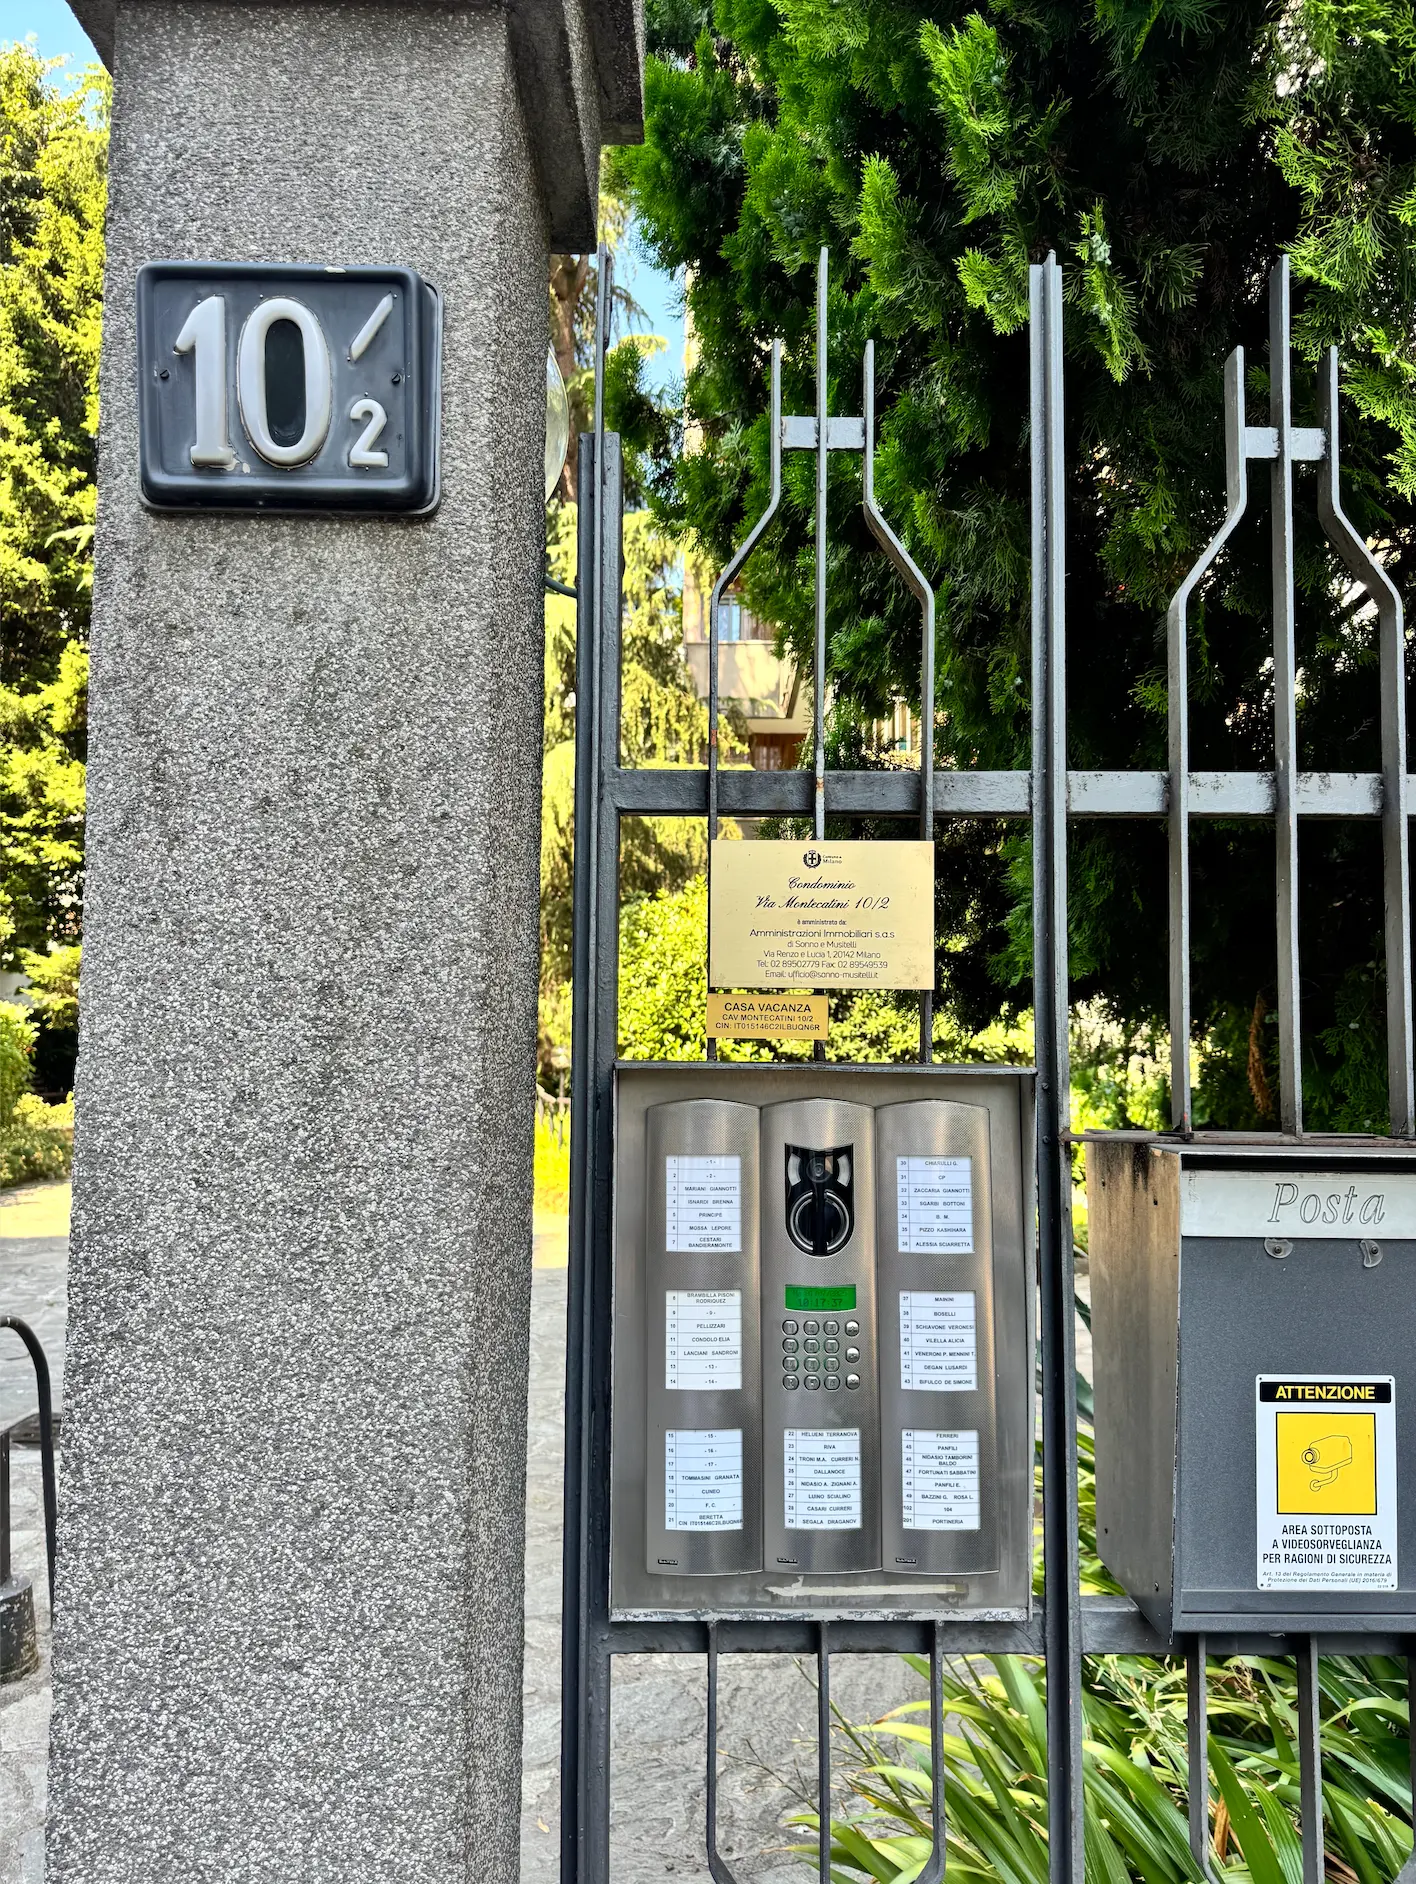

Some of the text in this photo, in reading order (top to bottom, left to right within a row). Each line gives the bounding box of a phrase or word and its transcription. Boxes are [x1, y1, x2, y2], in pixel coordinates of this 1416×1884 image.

[788, 876, 856, 890] Condominio
[754, 895, 890, 910] Via Montecatini 10/2
[749, 929, 822, 938] Amministrazioni
[823, 929, 872, 938] Immobiliari
[795, 940, 819, 948] Sonno
[826, 940, 857, 948] Musitelli
[827, 951, 832, 959] 1,
[782, 960, 820, 968] 89502779
[837, 960, 848, 969] 02
[849, 961, 888, 969] 89549539
[765, 970, 787, 978] Email:
[724, 1002, 812, 1013] CASA VACANZA
[1267, 1182, 1386, 1224] Posta
[1275, 1385, 1376, 1400] ATTENZIONE
[1281, 1524, 1372, 1536] AREA SOTTOPOSTA
[1272, 1539, 1383, 1550] A VIDEOSORVEGLIANZA
[1262, 1553, 1392, 1564] PER RAGIONI DI SICUREZZA
